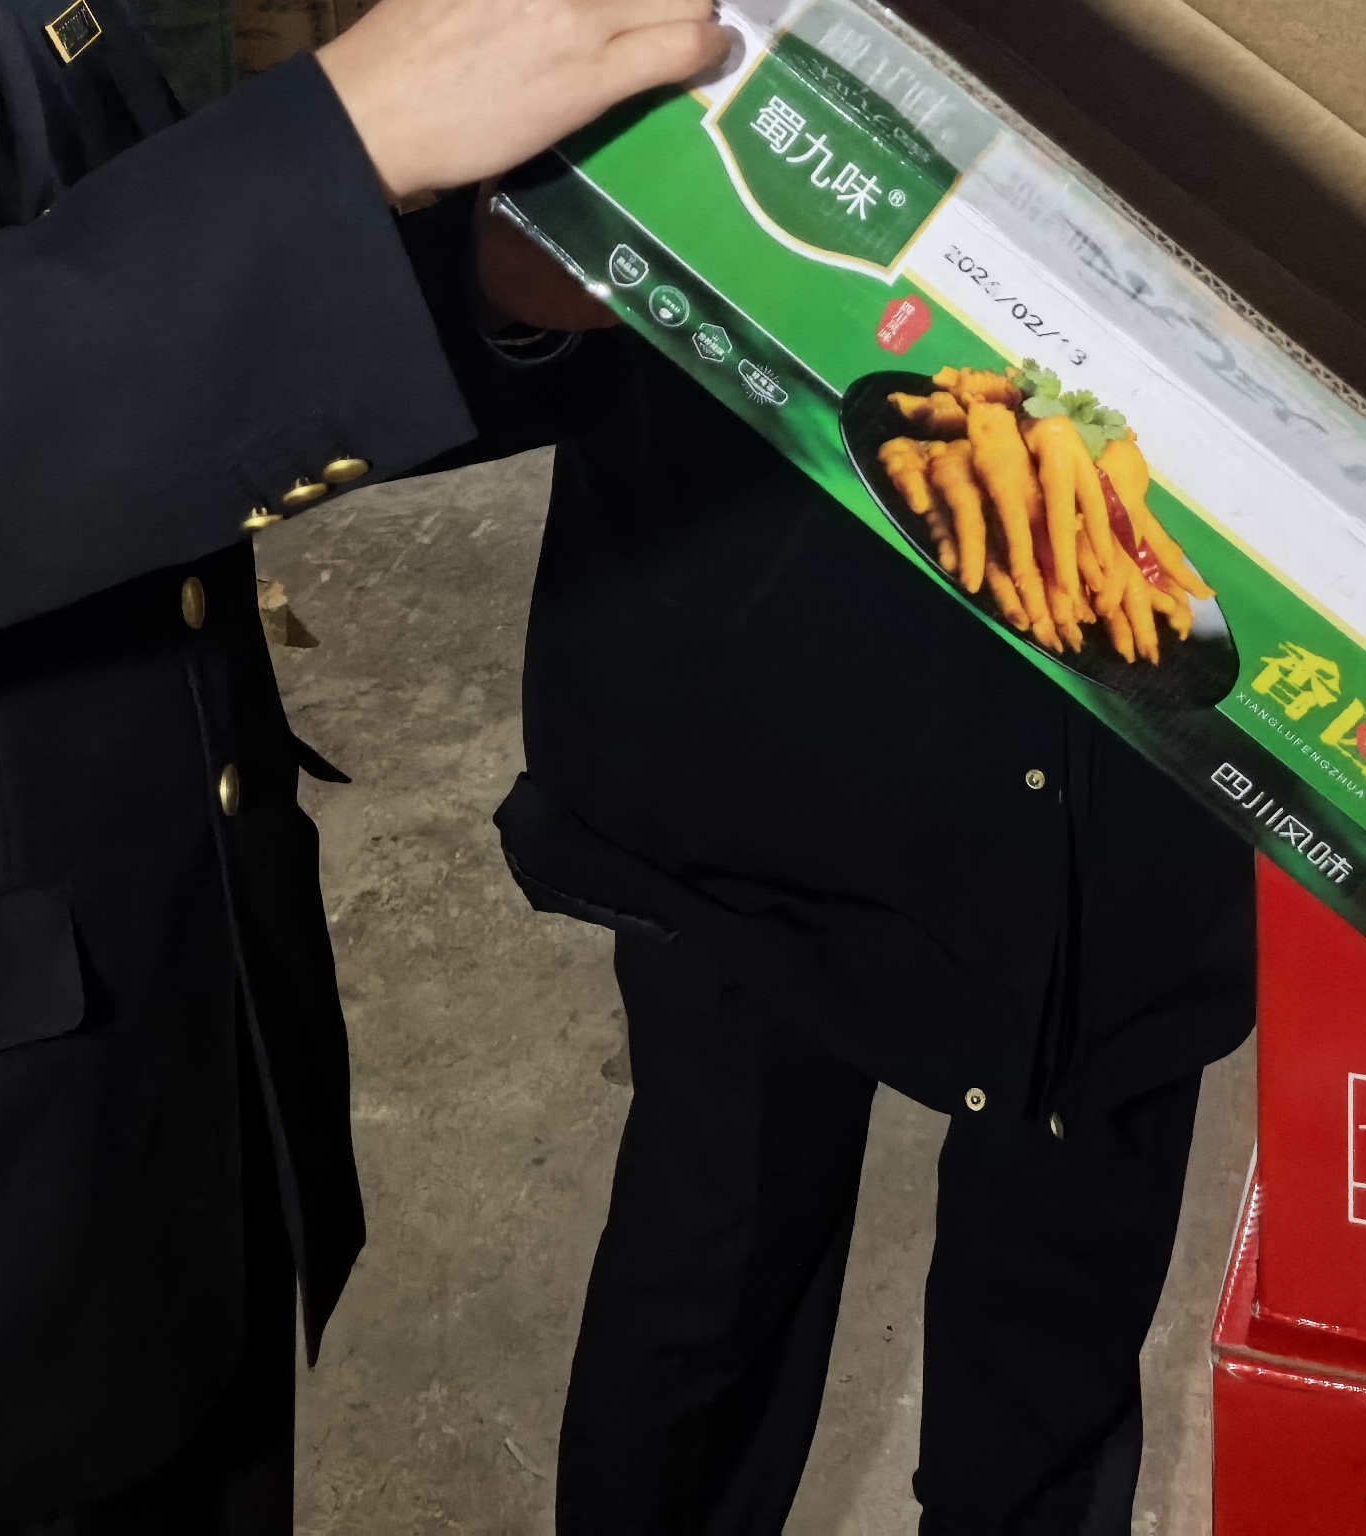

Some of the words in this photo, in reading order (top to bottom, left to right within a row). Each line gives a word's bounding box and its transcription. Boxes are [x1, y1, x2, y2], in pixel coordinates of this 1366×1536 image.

[749, 94, 884, 222] 蜀九味
[1235, 690, 1366, 800] XIANGLUFENGZHUA
